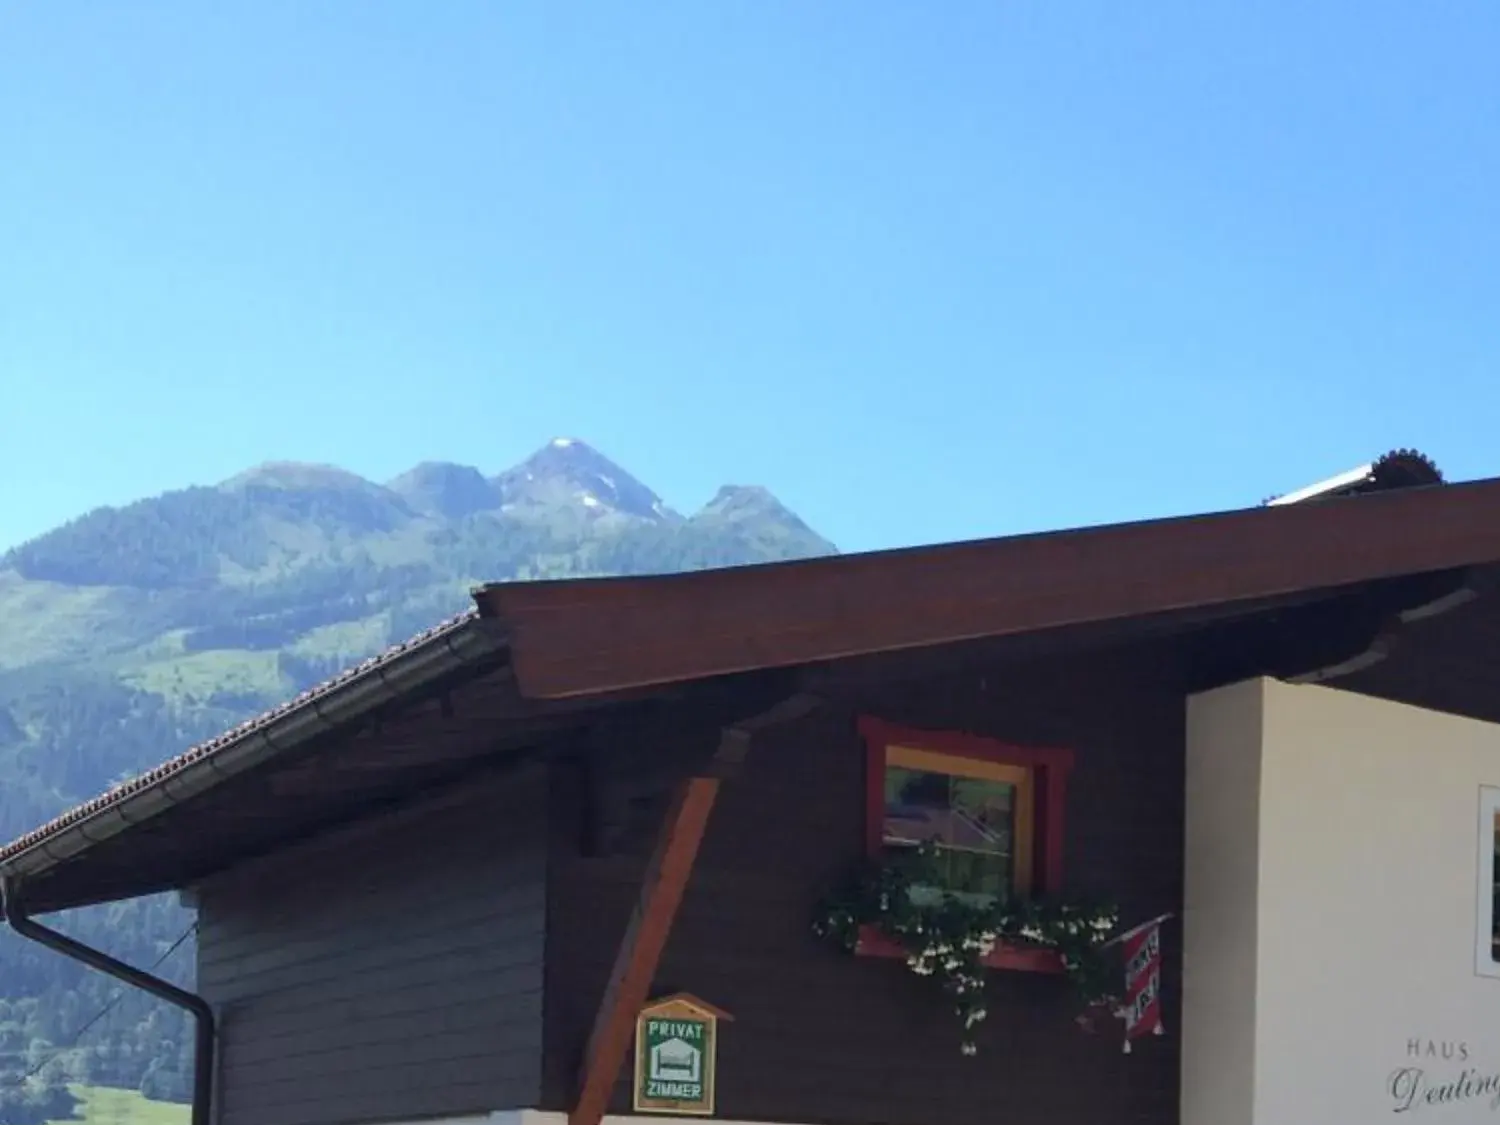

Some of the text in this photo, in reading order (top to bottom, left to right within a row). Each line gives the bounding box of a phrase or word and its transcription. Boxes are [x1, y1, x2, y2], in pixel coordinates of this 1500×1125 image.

[649, 1021, 703, 1038] PRIVAT
[1407, 1038, 1469, 1061] HAUS
[647, 1081, 701, 1097] ZIMMER
